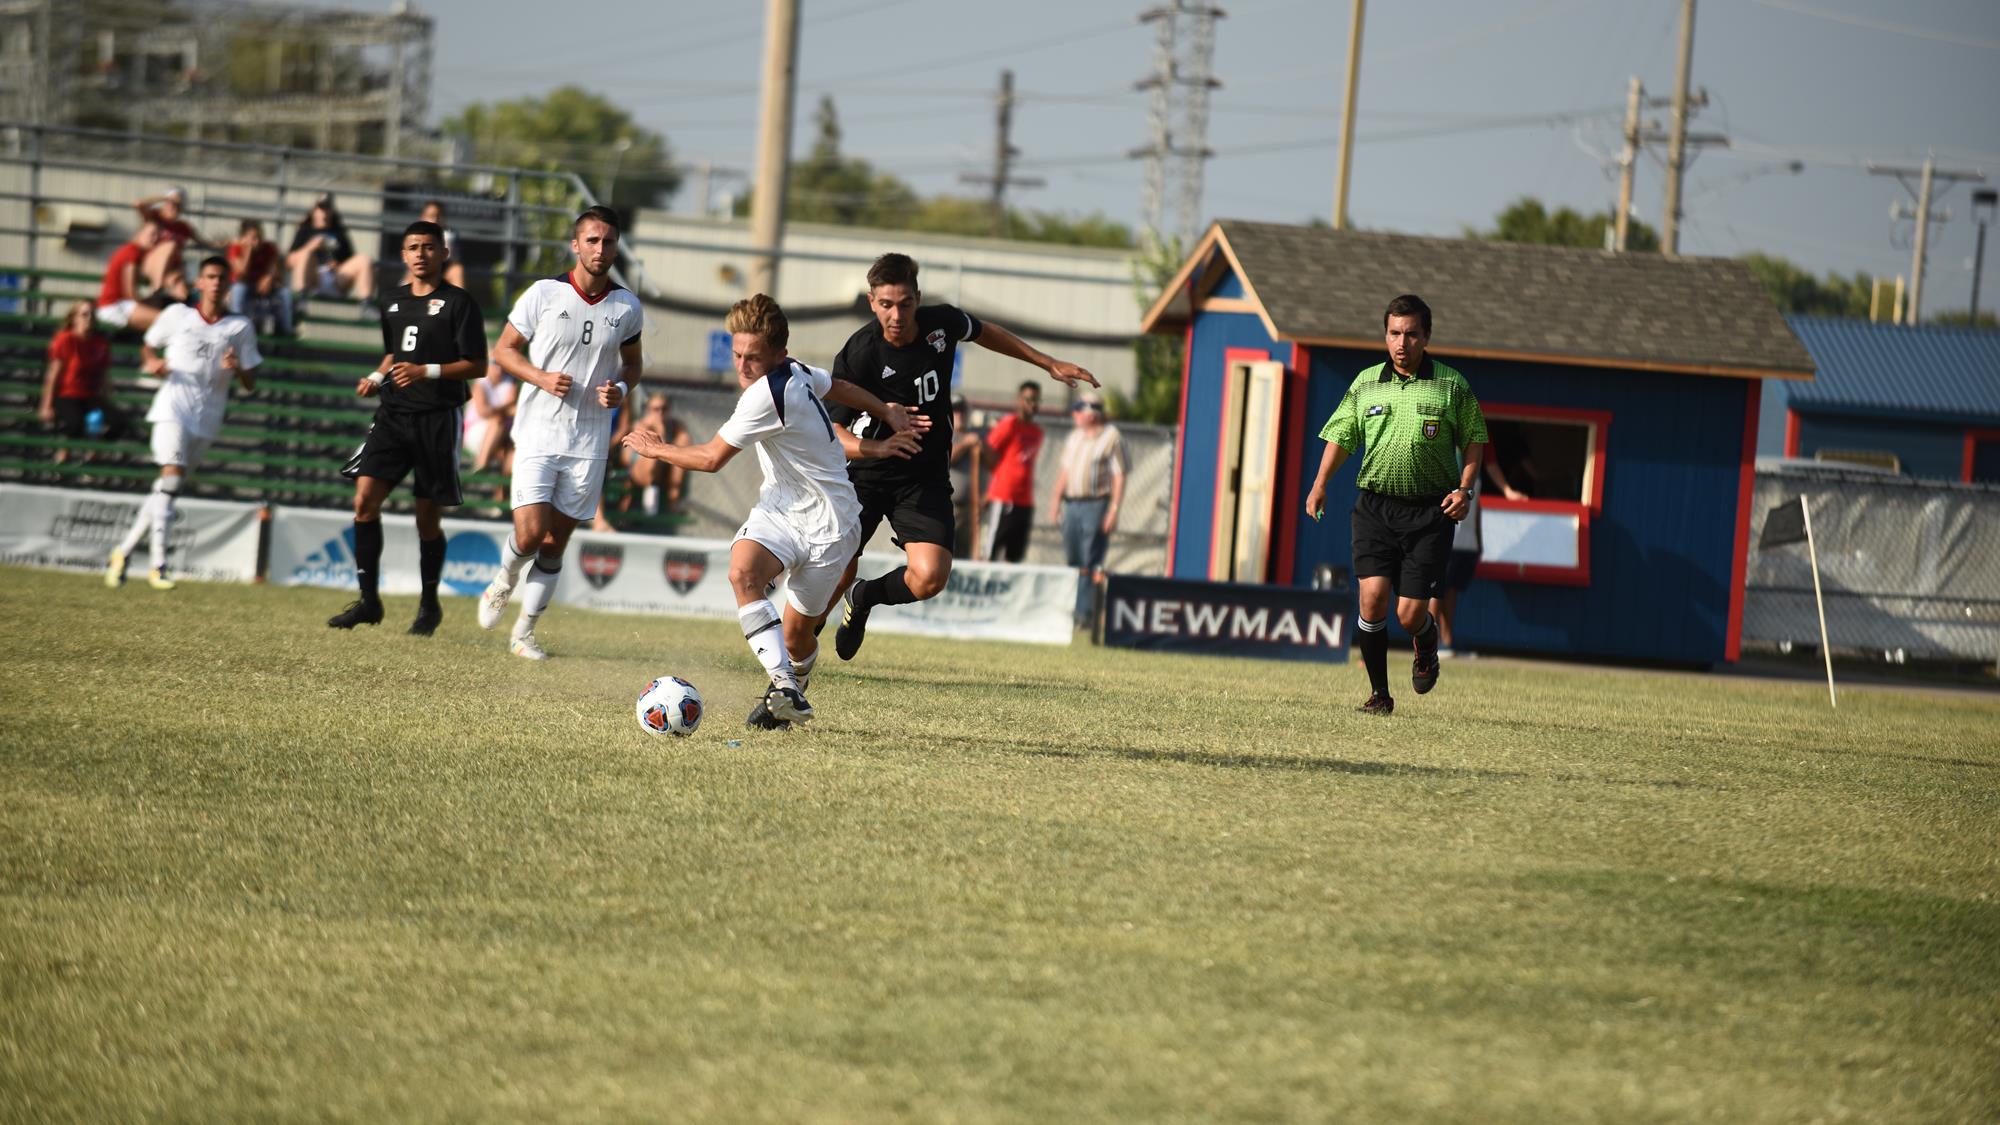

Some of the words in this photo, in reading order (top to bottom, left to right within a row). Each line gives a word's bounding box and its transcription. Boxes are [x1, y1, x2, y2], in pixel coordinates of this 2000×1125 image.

[401, 325, 418, 352] 6
[581, 320, 593, 345] 8
[913, 369, 939, 405] 10
[1113, 599, 1344, 649] NEWMAN
